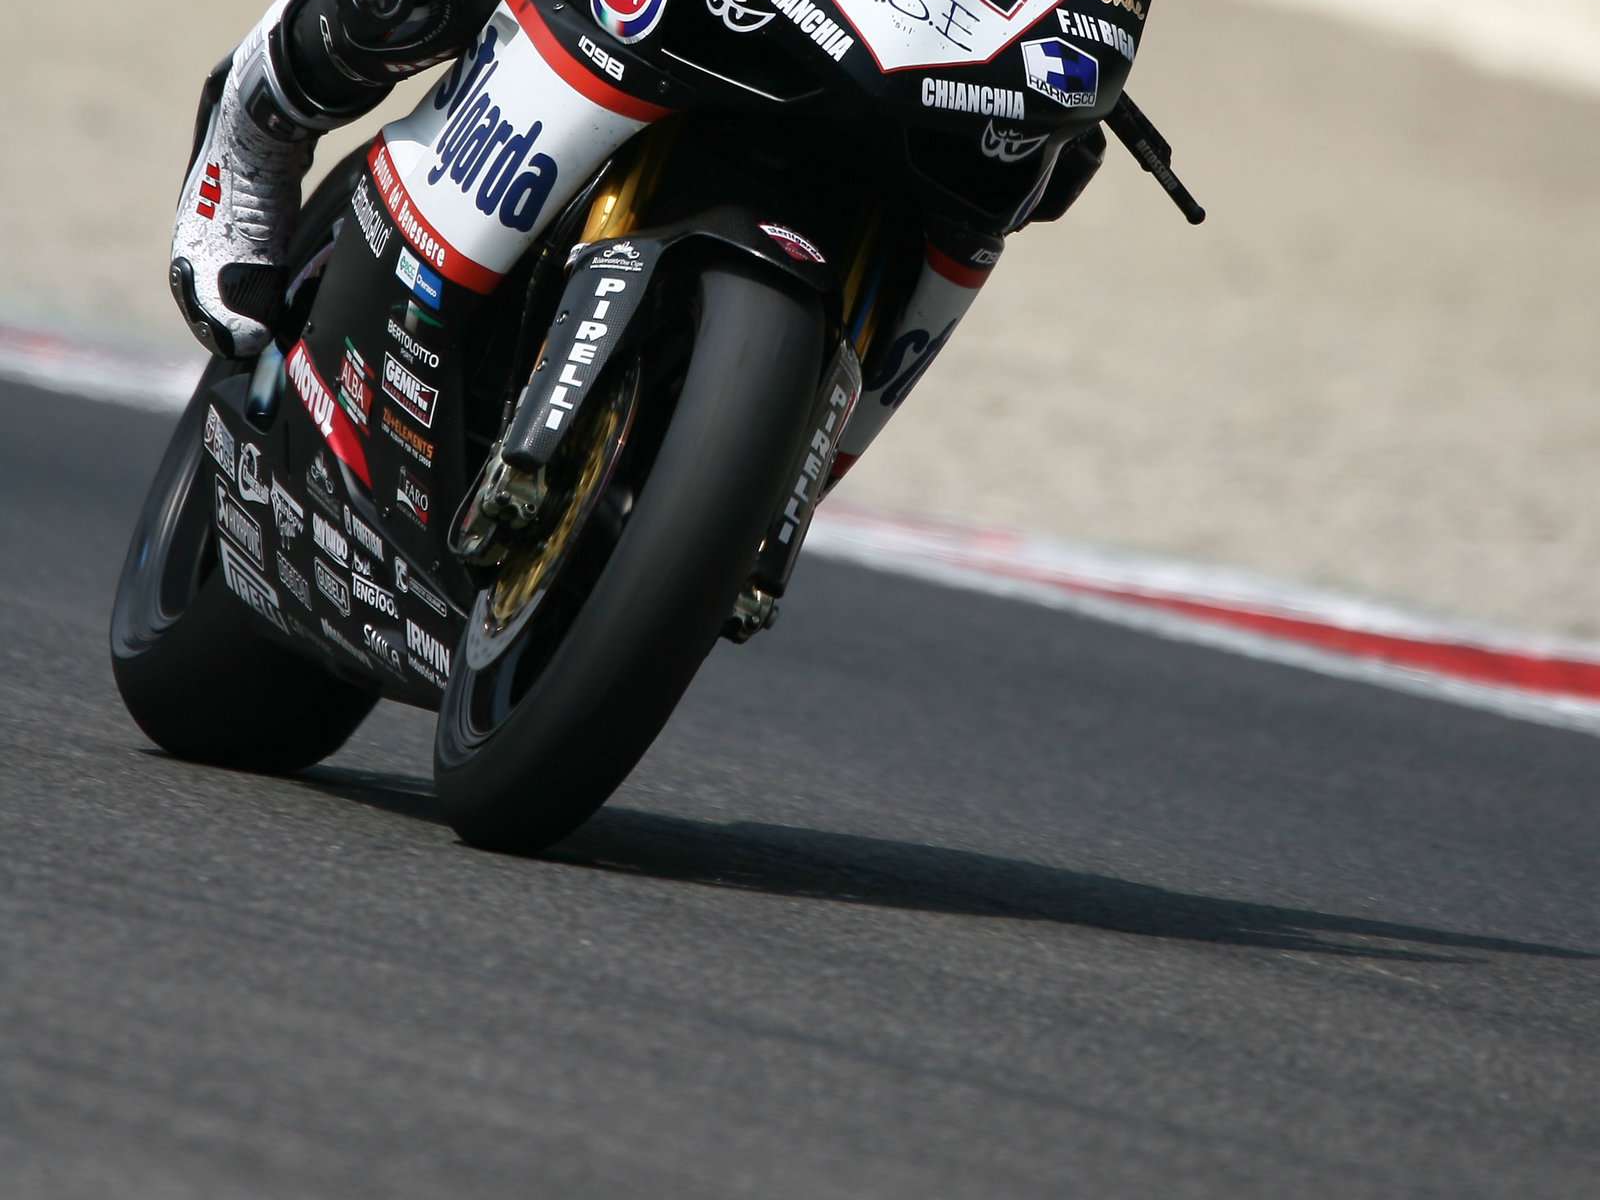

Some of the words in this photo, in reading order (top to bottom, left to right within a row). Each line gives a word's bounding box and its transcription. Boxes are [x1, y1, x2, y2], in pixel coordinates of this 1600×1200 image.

[577, 34, 625, 82] 1098
[921, 77, 1025, 120] CHIANCHIA
[1029, 75, 1096, 106] HARMSCO
[373, 146, 394, 194] Sponsor
[388, 183, 403, 212] del
[397, 199, 446, 267] Benessere
[388, 319, 439, 368] BERTOLOTTO
[545, 277, 626, 431] PIRELLI
[289, 345, 334, 438] MOTUL
[341, 361, 364, 409] ALBA
[777, 384, 847, 545] PIRELLI
[405, 480, 429, 511] FARO
[220, 537, 291, 636] PIRELLI
[406, 617, 450, 678] IRWIN
